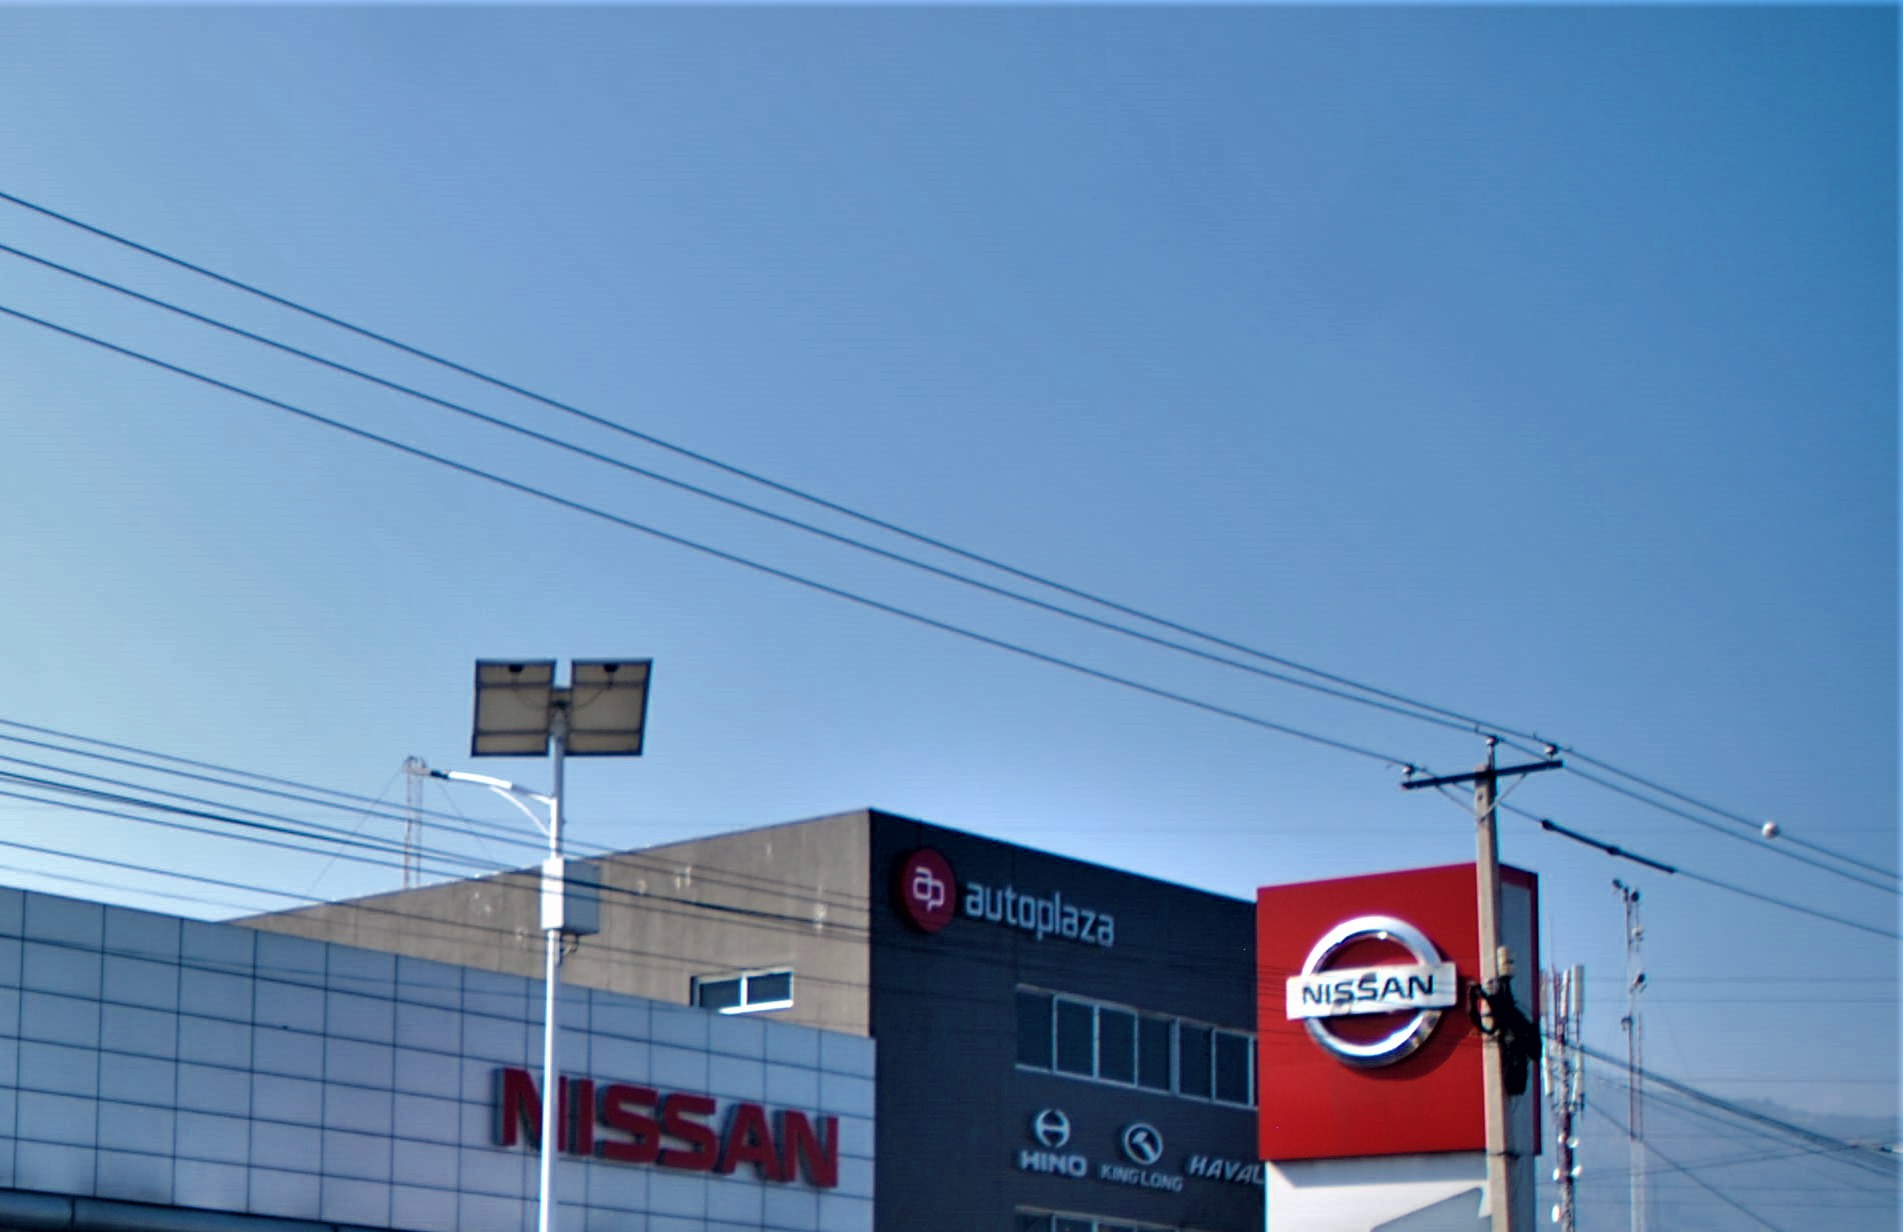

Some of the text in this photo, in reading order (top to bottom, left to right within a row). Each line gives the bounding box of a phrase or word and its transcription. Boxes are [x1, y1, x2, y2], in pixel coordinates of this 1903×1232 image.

[964, 880, 1116, 948] autoplaza
[1301, 972, 1436, 1006] NISSAN
[496, 1066, 839, 1189] NISSAN
[1019, 1150, 1088, 1178] HINO
[1189, 1154, 1265, 1185] HAVAL
